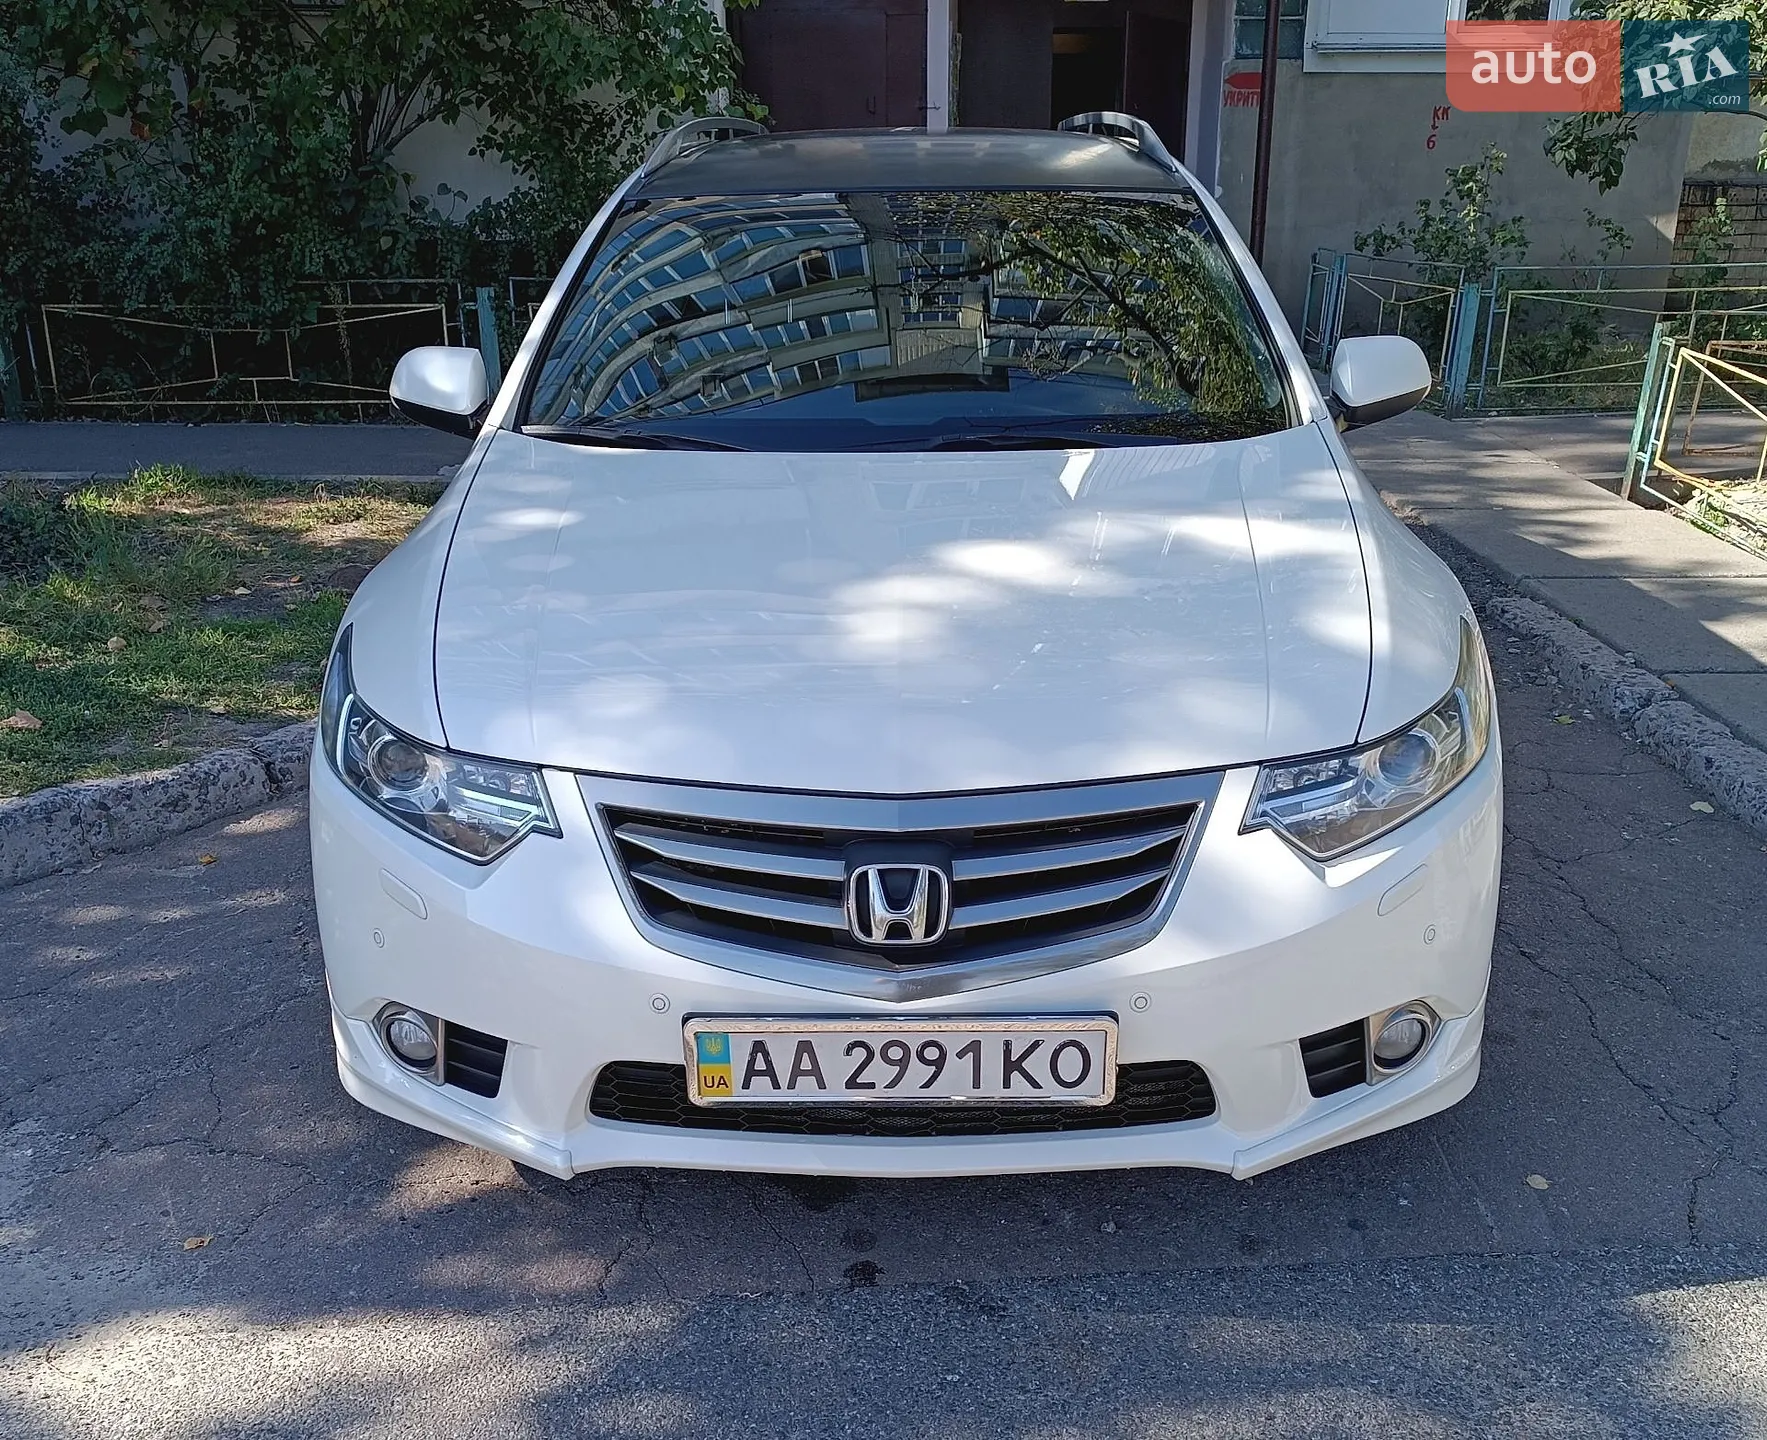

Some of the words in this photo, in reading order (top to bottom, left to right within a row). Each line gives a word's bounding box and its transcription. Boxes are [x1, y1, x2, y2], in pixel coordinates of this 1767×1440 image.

[1427, 134, 1437, 150] 6
[741, 1039, 828, 1090] AA
[843, 1039, 982, 1090] 2991
[1002, 1039, 1092, 1090] KO
[703, 1075, 730, 1089] UA
